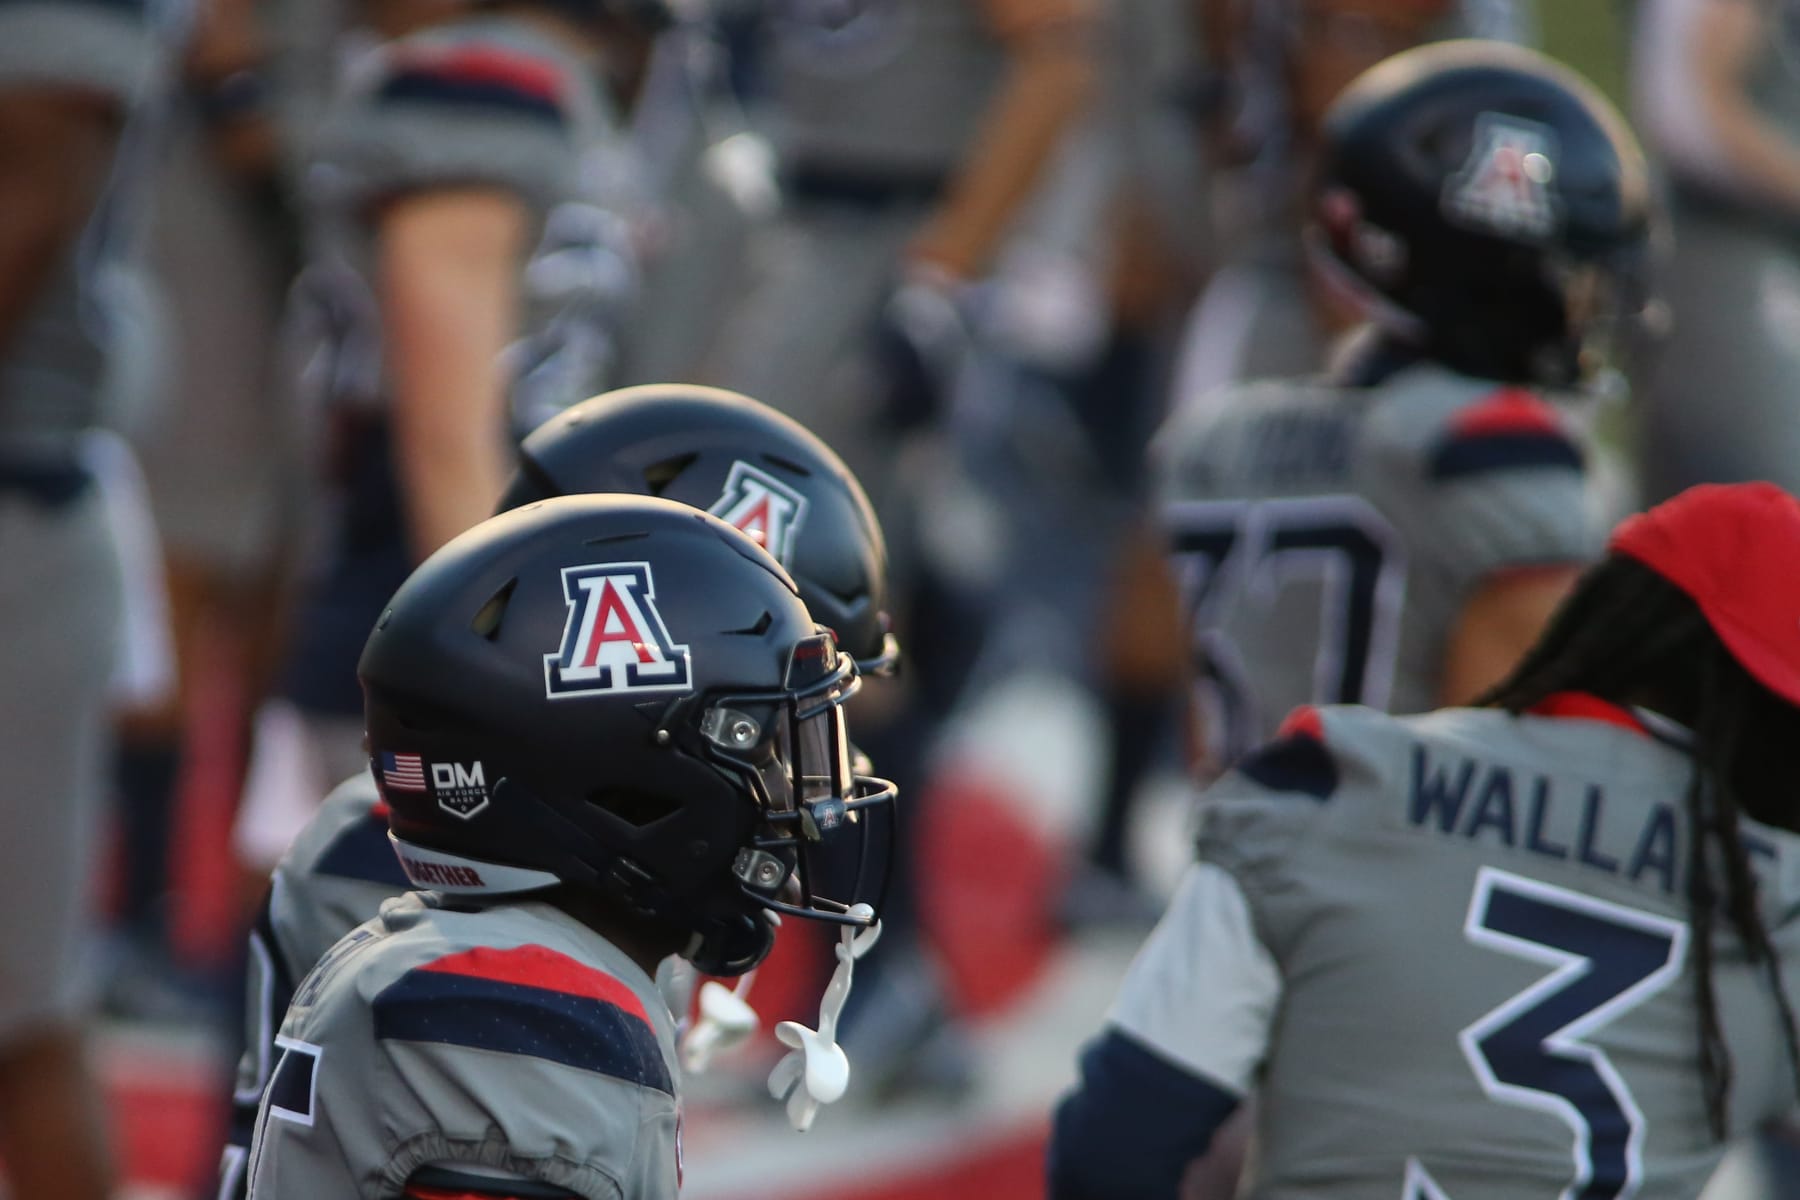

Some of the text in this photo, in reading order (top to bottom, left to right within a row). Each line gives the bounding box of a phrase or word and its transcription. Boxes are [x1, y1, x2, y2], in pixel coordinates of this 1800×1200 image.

[543, 560, 693, 699] A
[431, 760, 486, 788] DM
[1405, 743, 1781, 893] WALLA
[1403, 865, 1690, 1200] 3
